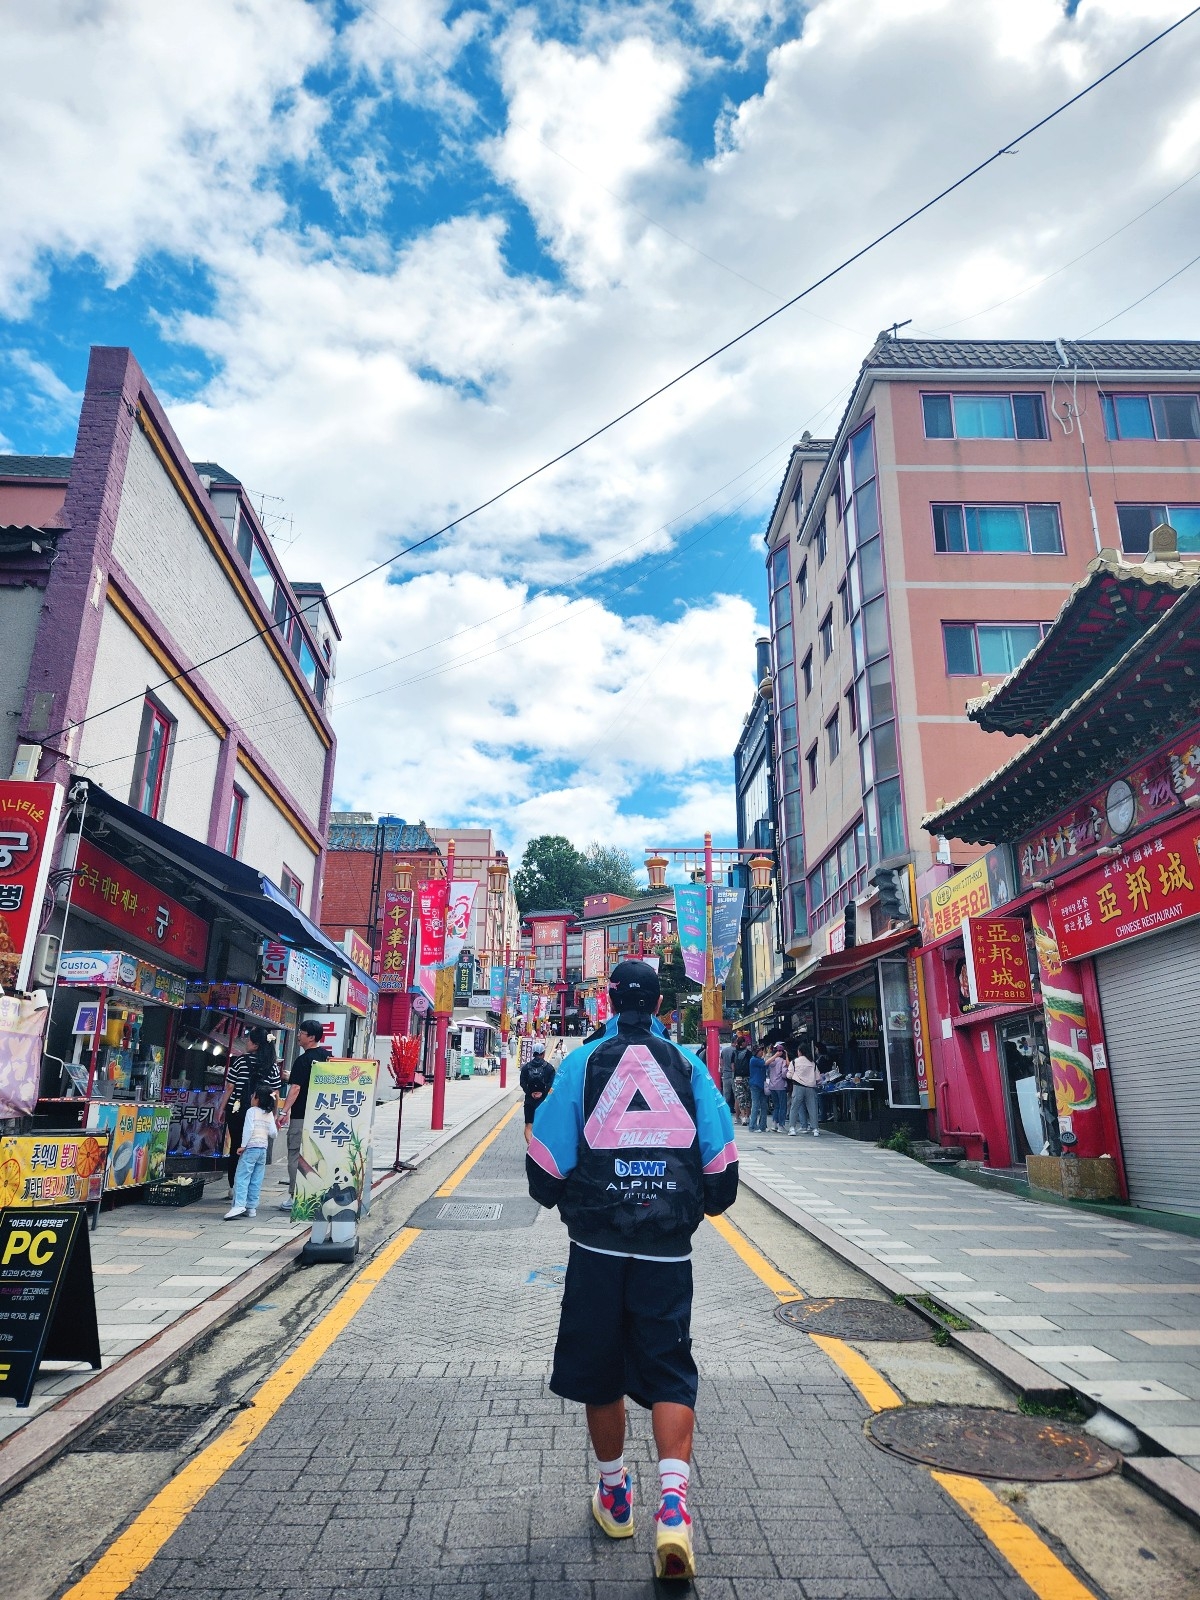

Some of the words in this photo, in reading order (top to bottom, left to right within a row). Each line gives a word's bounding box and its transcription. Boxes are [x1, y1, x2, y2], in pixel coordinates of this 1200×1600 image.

[78, 861, 99, 894] 중국
[101, 877, 120, 906] 대만
[1096, 853, 1194, 926] 亞邦城
[156, 906, 169, 939] 궁
[934, 883, 991, 935] 정통중국요리
[1115, 923, 1144, 940] CHINESE
[1142, 903, 1184, 931] RESTAURANT
[986, 924, 1018, 988] 亞邦城
[912, 999, 926, 1077] 3900
[594, 1075, 625, 1125] PALACE
[642, 1060, 680, 1106] PALACE
[314, 1089, 366, 1117] 사탕
[312, 1112, 351, 1147] 수수
[618, 1130, 671, 1146] PALACE
[31, 1144, 59, 1171] 추억의
[629, 1160, 666, 1177] BWT
[605, 1180, 677, 1191] ALPINE
[1, 1230, 58, 1266] PC
